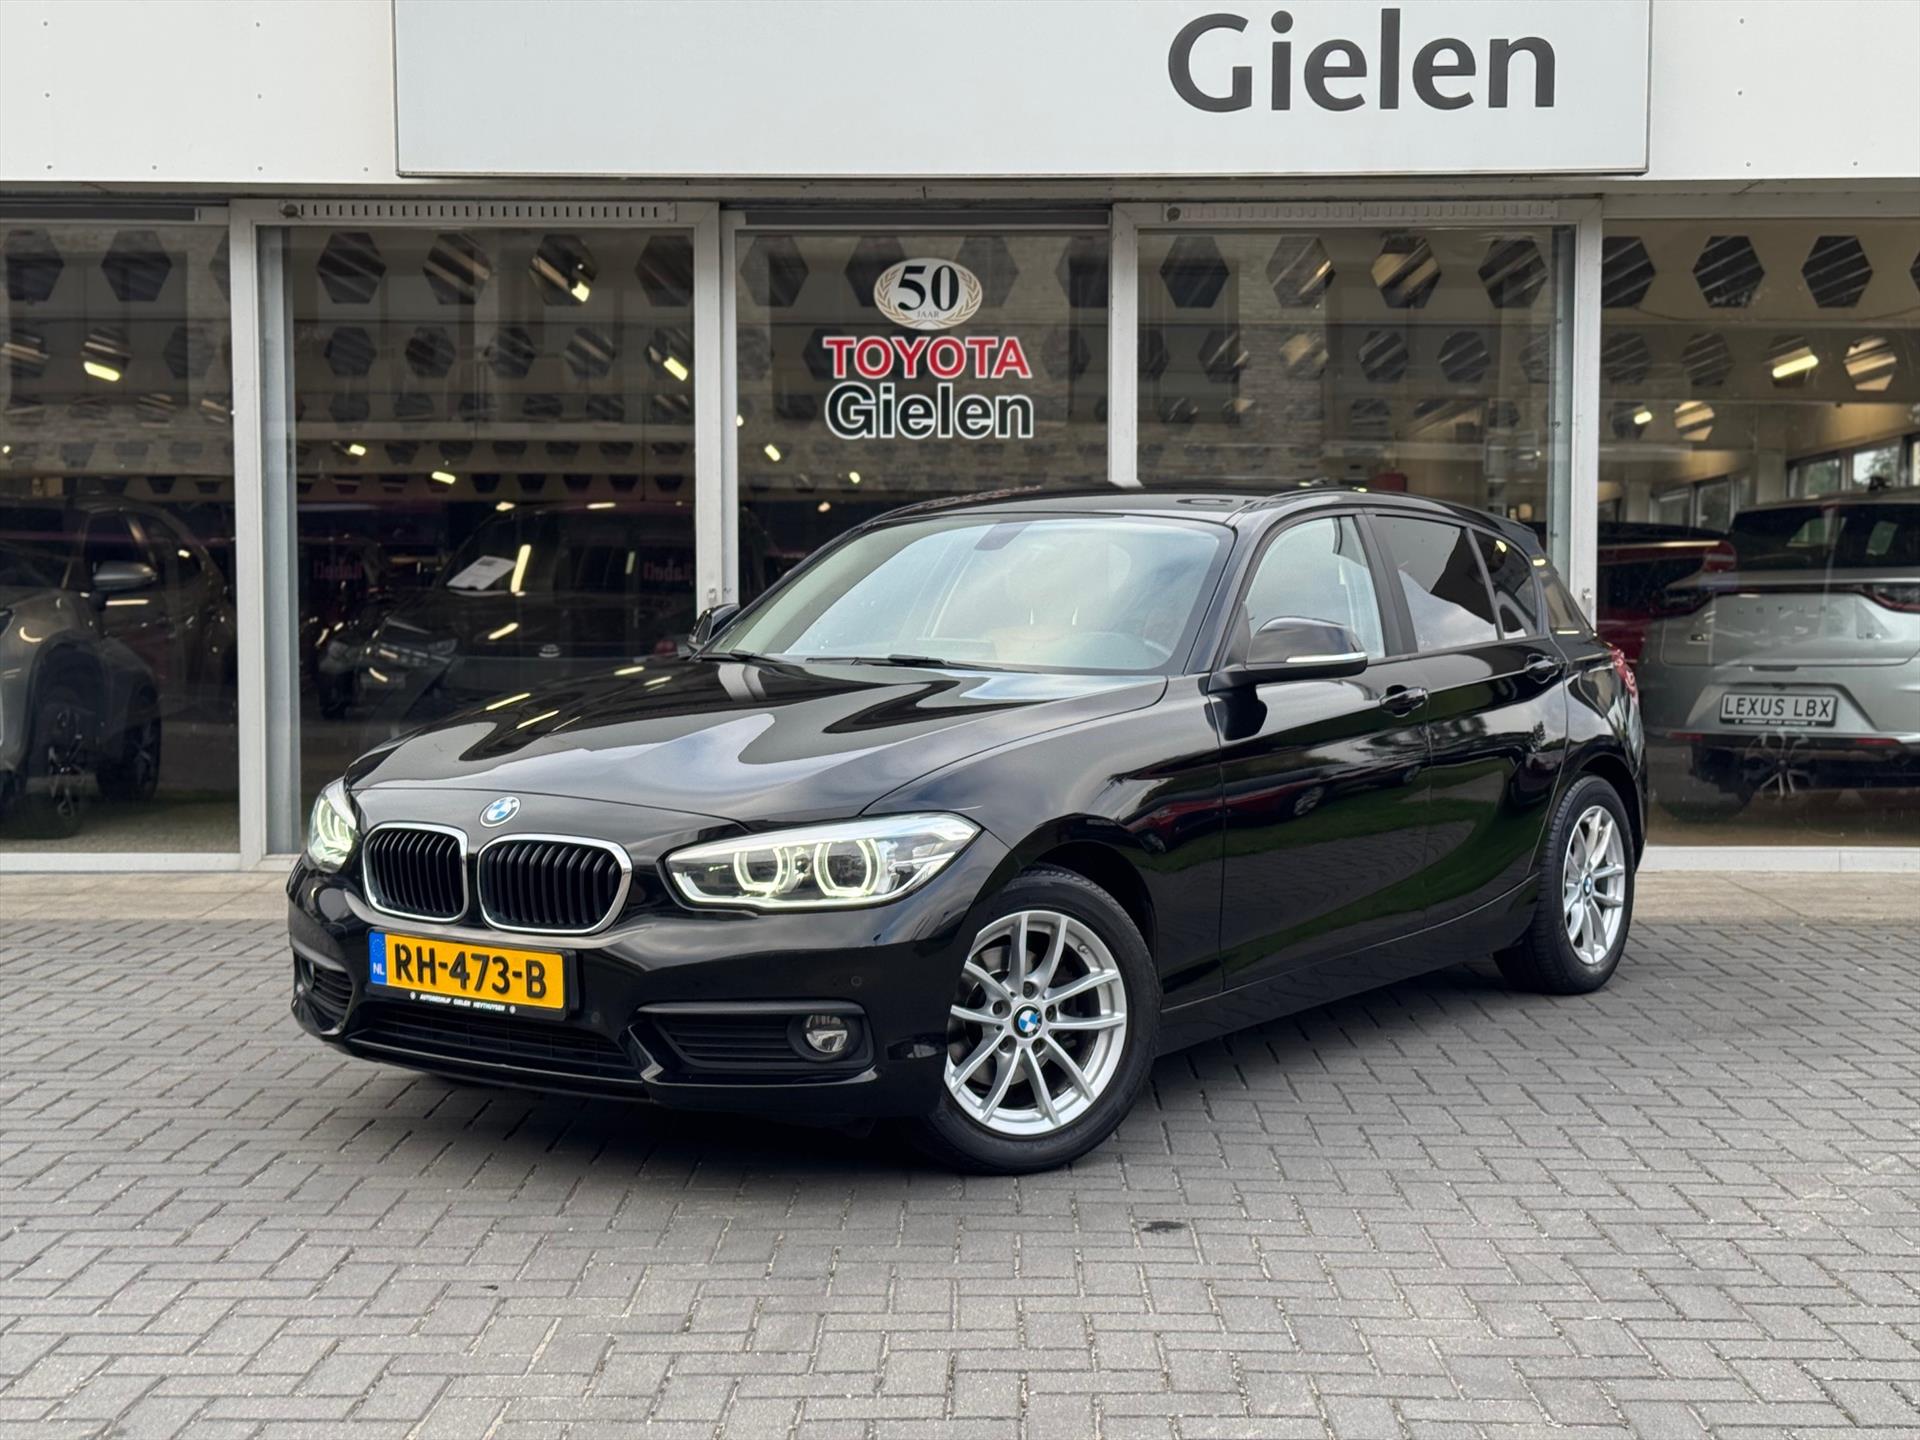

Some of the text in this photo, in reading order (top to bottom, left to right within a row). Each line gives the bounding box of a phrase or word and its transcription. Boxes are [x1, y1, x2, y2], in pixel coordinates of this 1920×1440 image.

[1168, 8, 1555, 113] Gielen
[897, 264, 960, 312] 50
[916, 311, 940, 319] JAAR
[822, 335, 1033, 380] TOYOTA
[824, 381, 1034, 440] Gielen
[1724, 696, 1831, 718] LEXUS LBX
[372, 962, 385, 977] NL
[394, 943, 547, 999] RH-473-B
